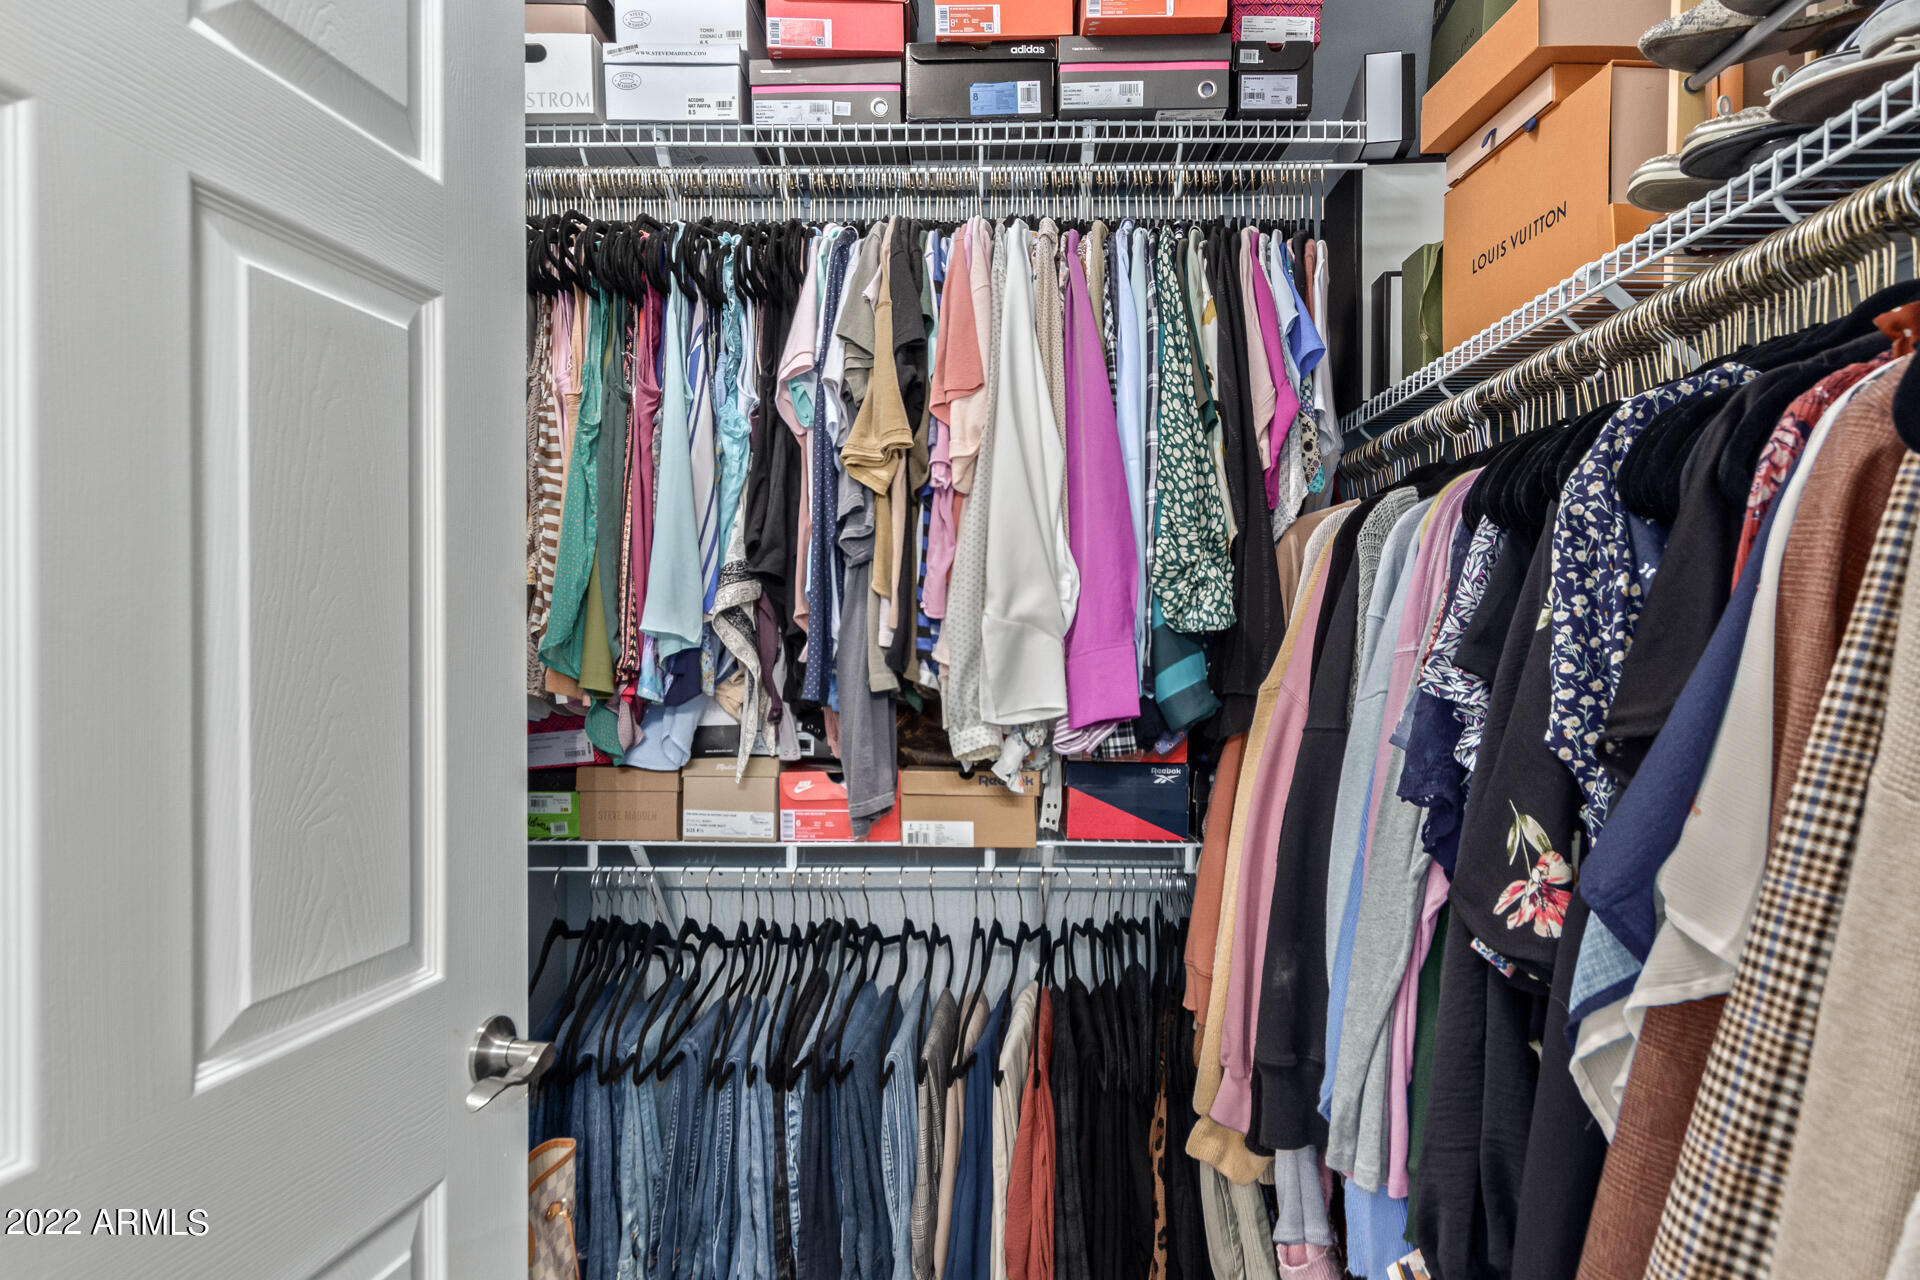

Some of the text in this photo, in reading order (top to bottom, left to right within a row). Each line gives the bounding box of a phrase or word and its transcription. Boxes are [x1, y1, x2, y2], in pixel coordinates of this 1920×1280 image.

[1010, 45, 1045, 54] adidas
[1472, 200, 1567, 275] LOUIS VUITTON
[1151, 767, 1181, 775] Reebok
